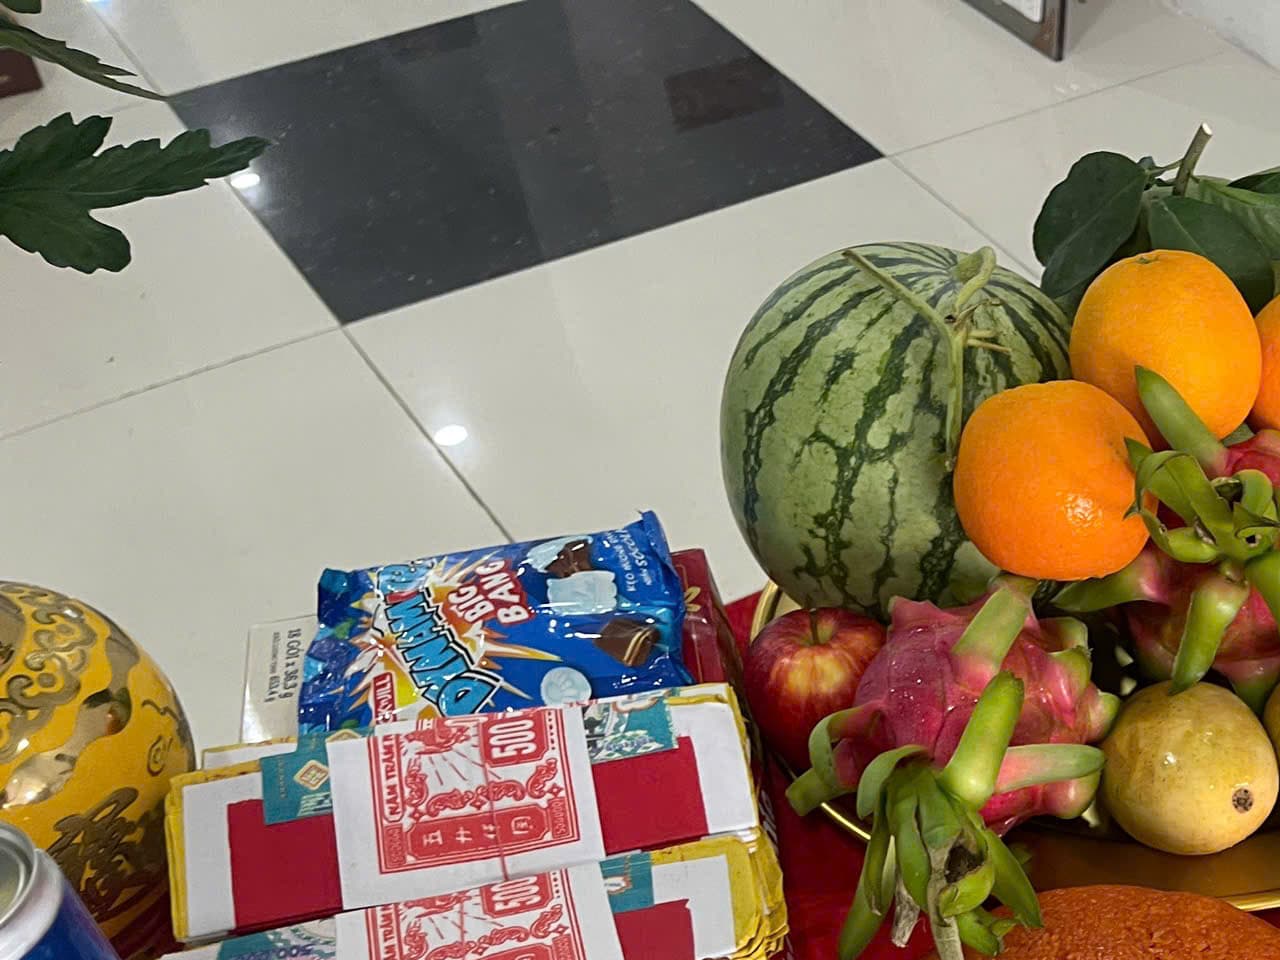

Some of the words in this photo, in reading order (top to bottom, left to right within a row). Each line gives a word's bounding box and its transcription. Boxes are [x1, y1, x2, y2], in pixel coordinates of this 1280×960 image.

[448, 583, 496, 625] BIG
[480, 559, 531, 627] BANG
[489, 719, 536, 759] 500
